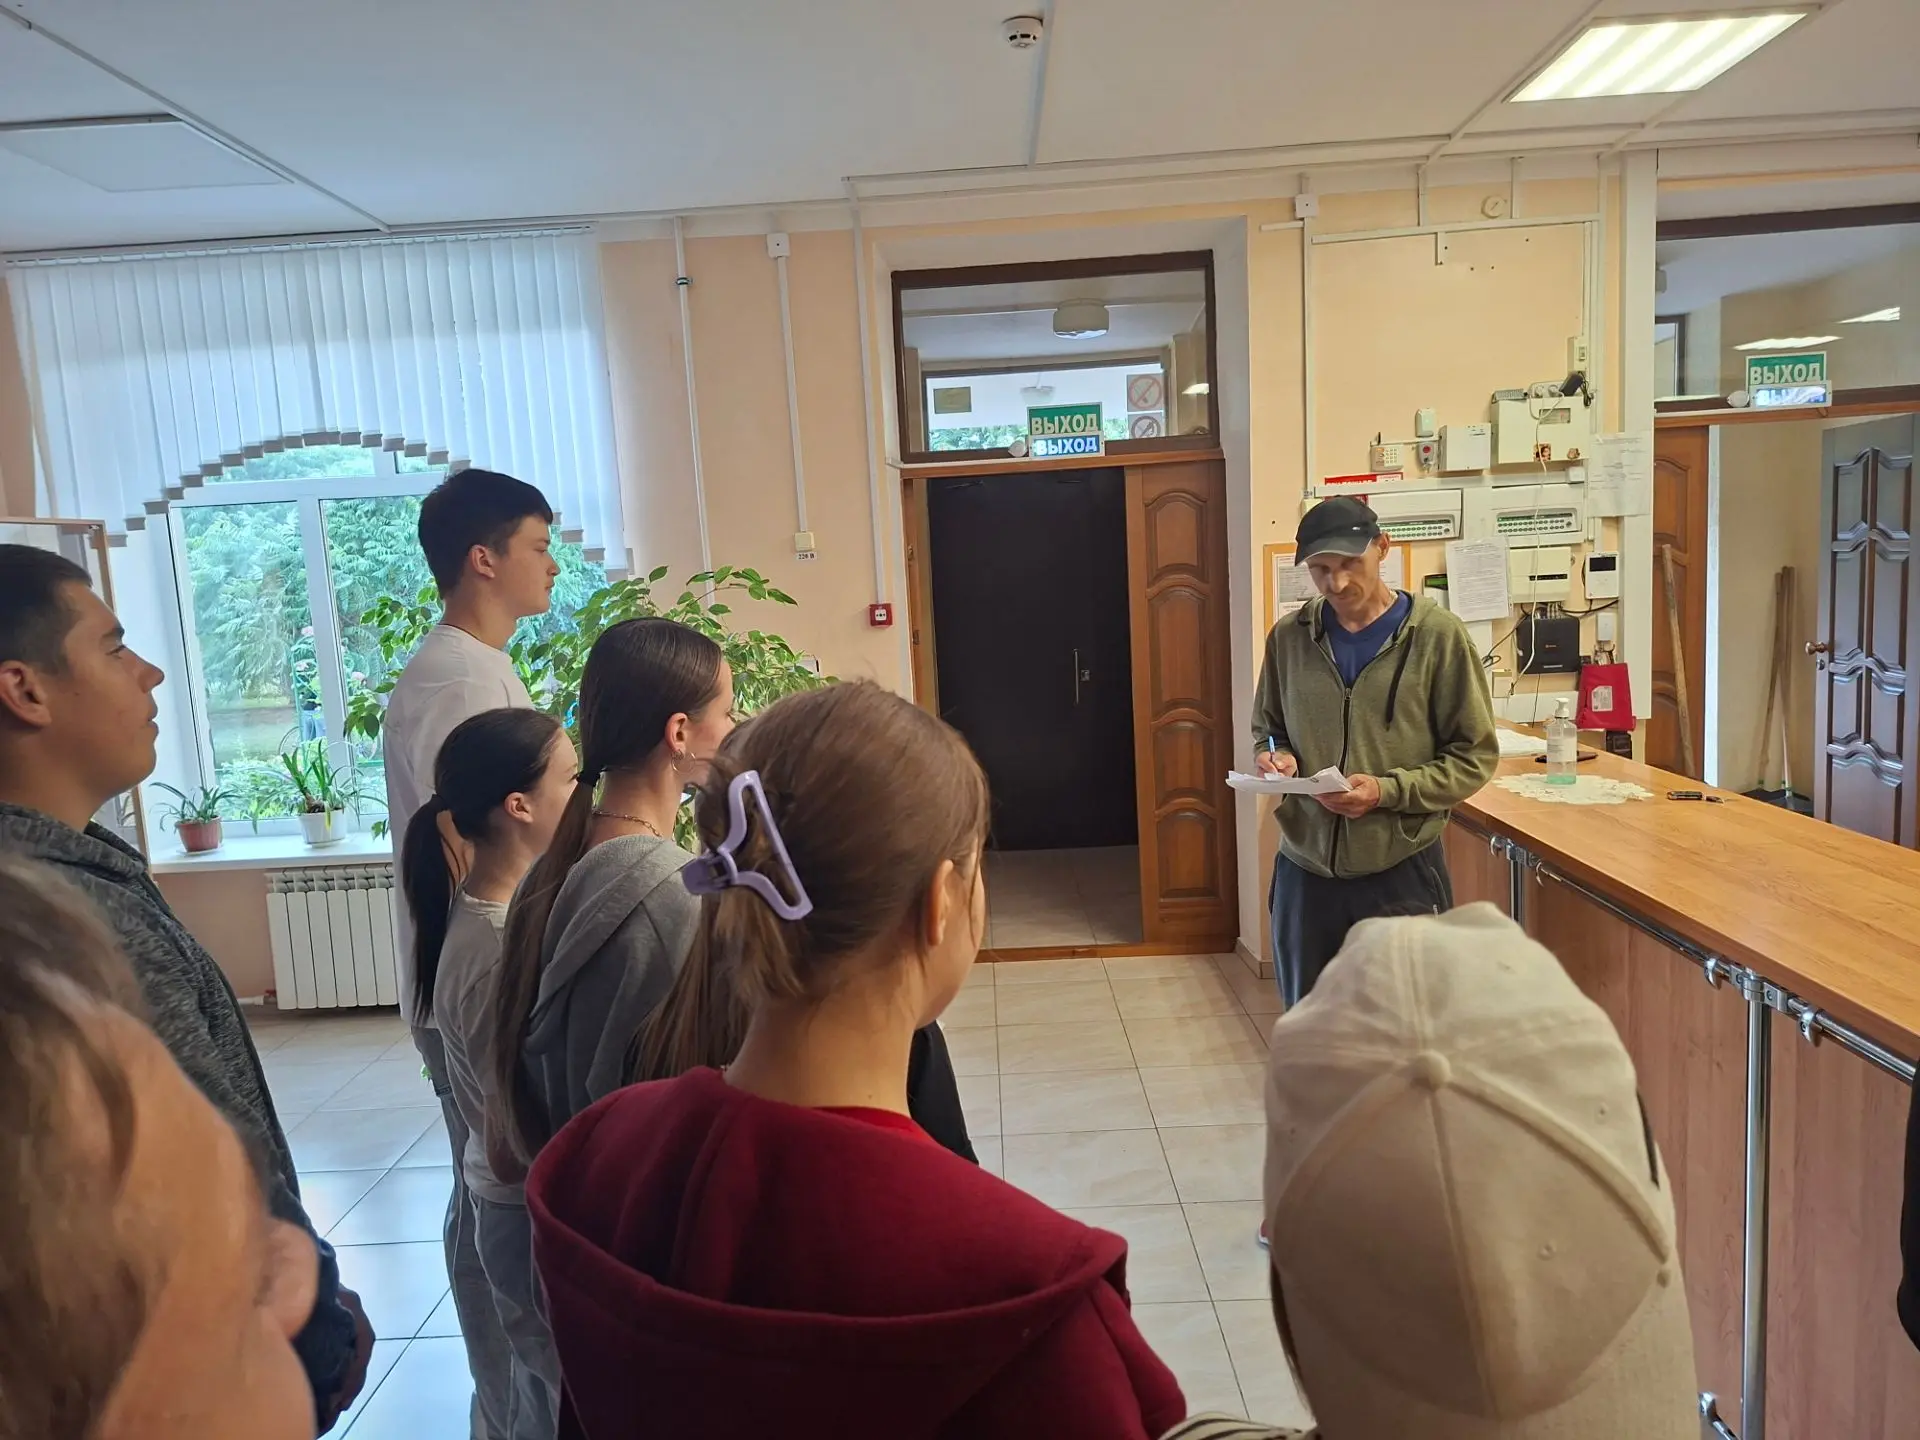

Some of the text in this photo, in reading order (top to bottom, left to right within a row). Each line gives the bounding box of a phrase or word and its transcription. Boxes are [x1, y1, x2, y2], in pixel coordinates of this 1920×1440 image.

[1750, 363, 1821, 385] ВЫХОД
[1031, 413, 1099, 435] ВЫХОД
[1035, 437, 1098, 456] ВЫХОД
